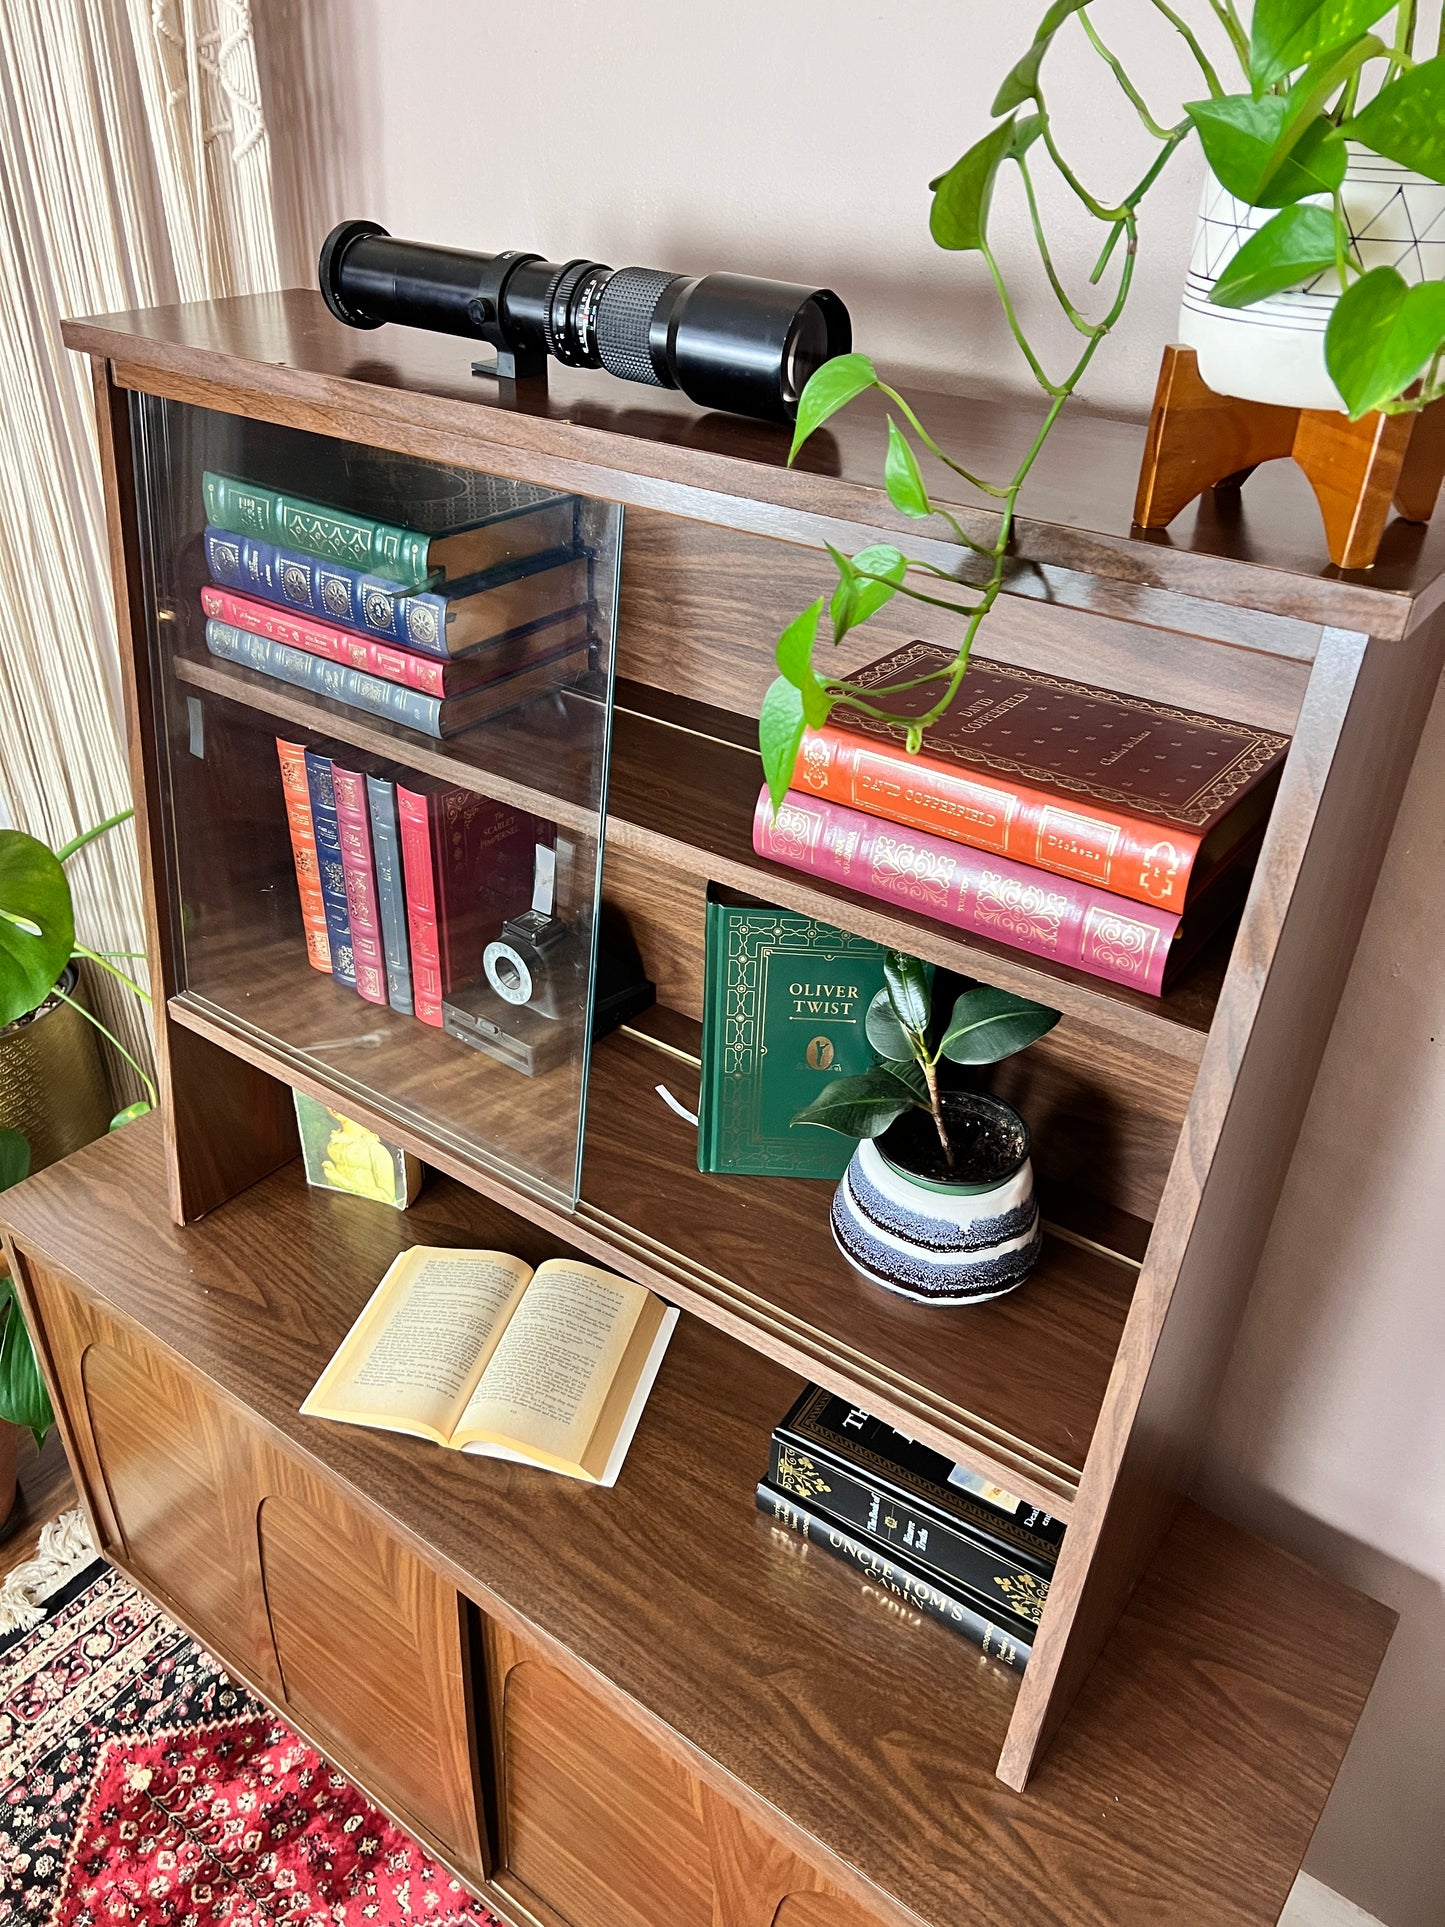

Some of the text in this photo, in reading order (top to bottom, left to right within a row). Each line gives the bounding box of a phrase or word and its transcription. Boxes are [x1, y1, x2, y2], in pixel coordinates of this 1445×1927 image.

[958, 698, 994, 718] DAVID
[961, 693, 1029, 733] COPPERFIELD
[904, 788, 997, 828] COPPERFIELD
[834, 839, 847, 867] ANNA
[1047, 834, 1100, 860] Dickens
[788, 982, 860, 999] OLIVER
[792, 1000, 854, 1015] TWIST
[829, 1531, 964, 1621] UNCLE TOM'S
[864, 1568, 924, 1610] CABIN
